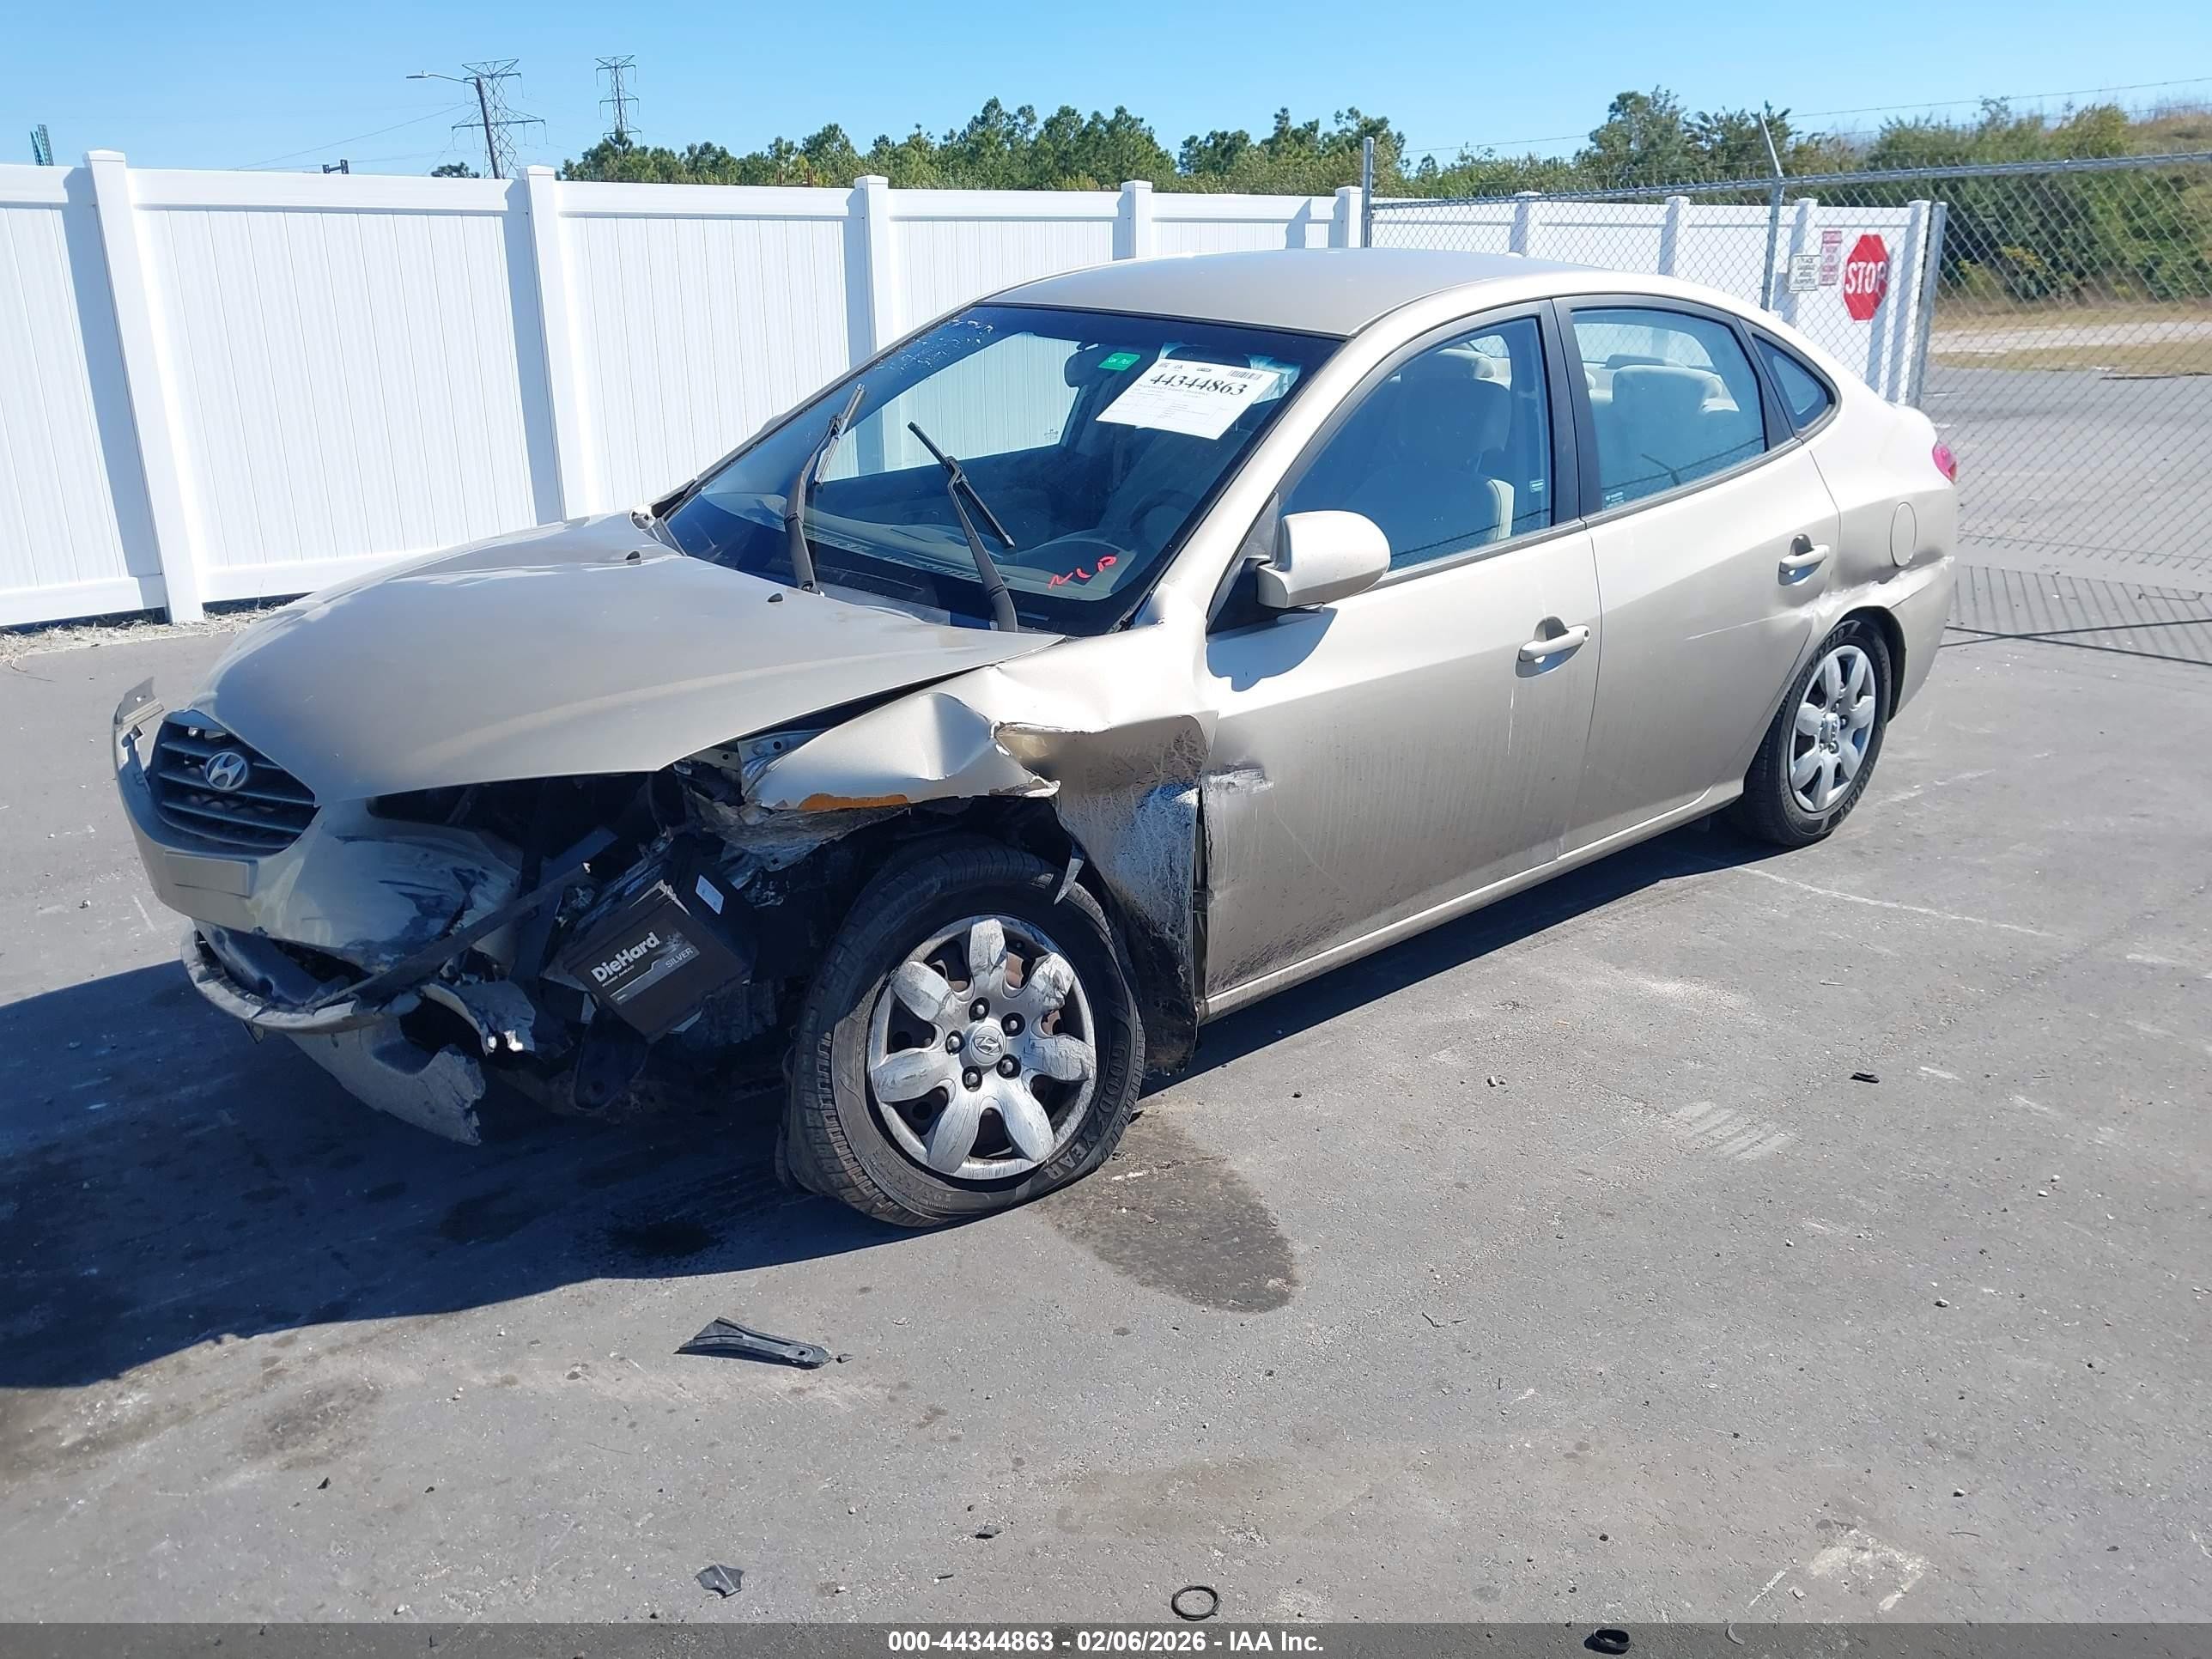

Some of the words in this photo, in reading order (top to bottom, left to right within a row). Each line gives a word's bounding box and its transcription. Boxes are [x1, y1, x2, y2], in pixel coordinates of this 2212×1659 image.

[1846, 261, 1887, 295] STOP
[1149, 373, 1248, 396] 44344863
[590, 932, 661, 982] DieHard
[665, 947, 694, 969] SILVER
